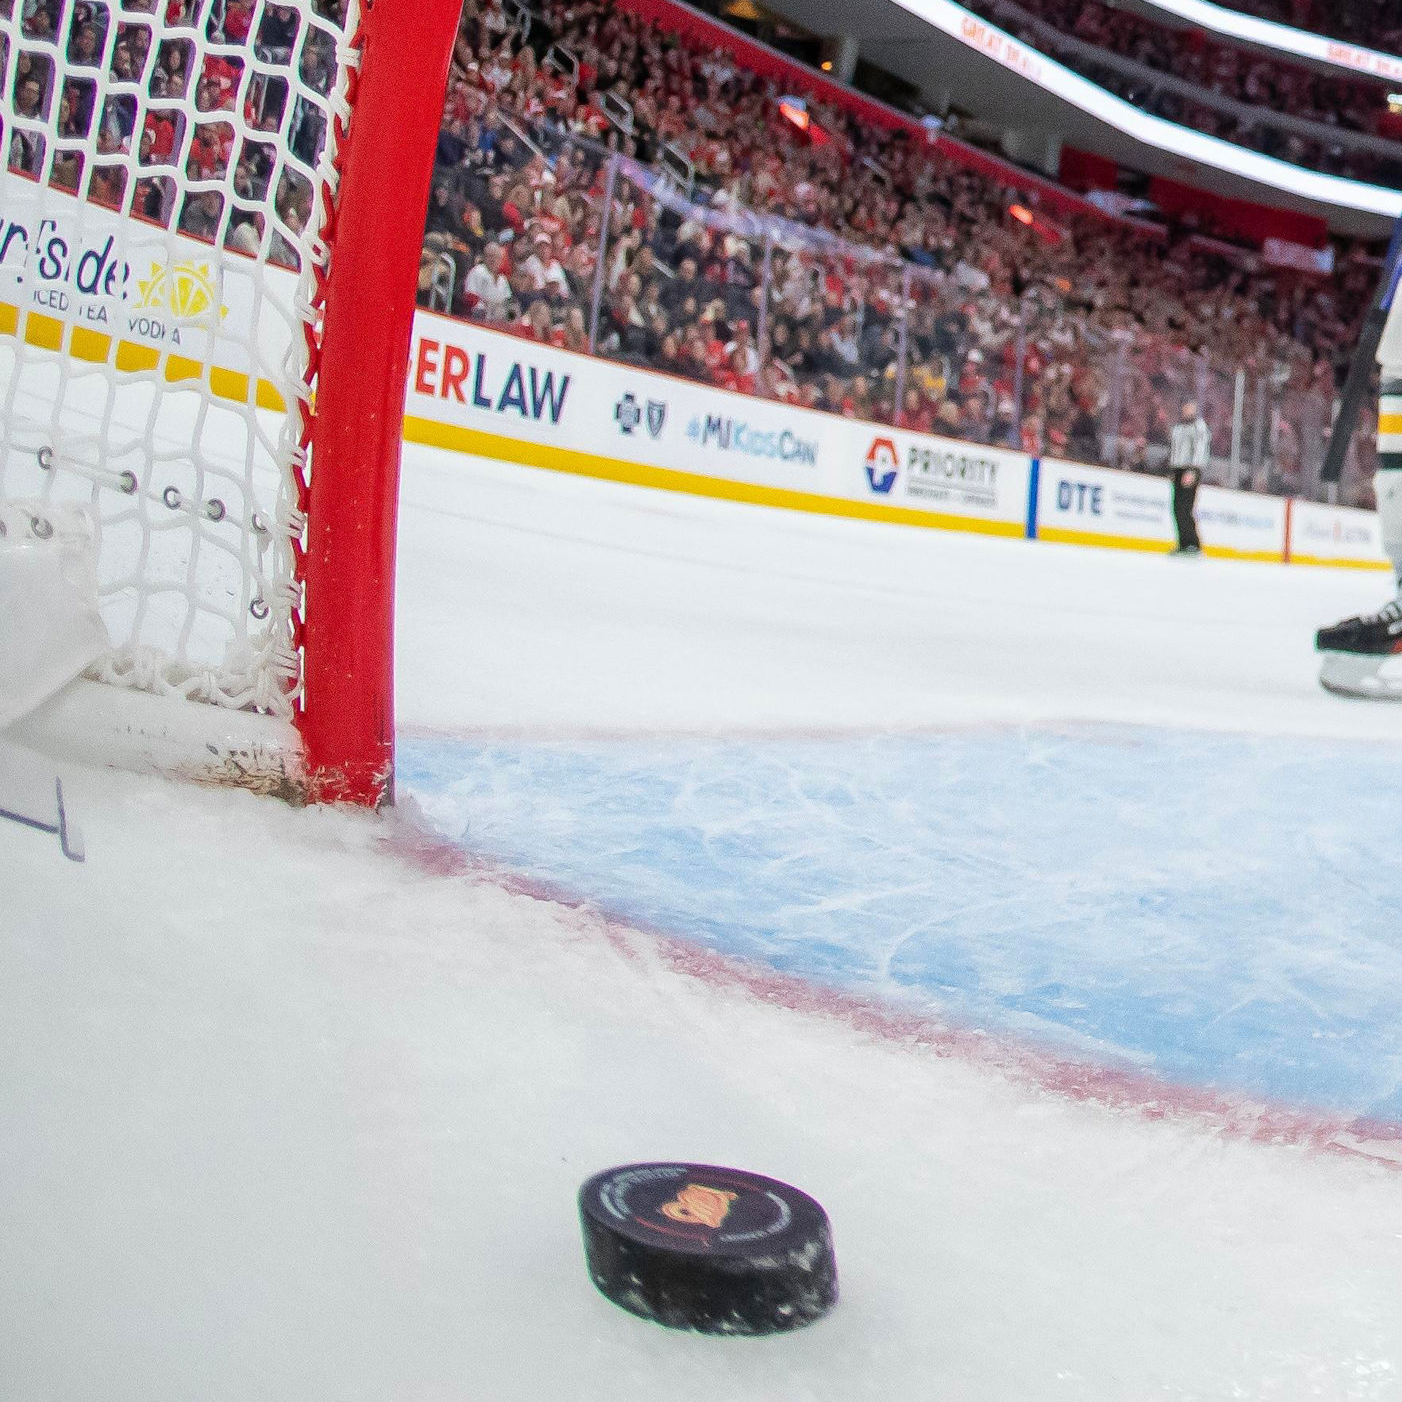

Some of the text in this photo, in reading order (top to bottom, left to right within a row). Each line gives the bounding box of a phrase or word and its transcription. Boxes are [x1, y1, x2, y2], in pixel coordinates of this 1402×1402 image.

[32, 289, 70, 312] ICED
[407, 336, 572, 426] ERLAW
[907, 446, 999, 484] PRIORITY
[1056, 479, 1103, 517] DTE
